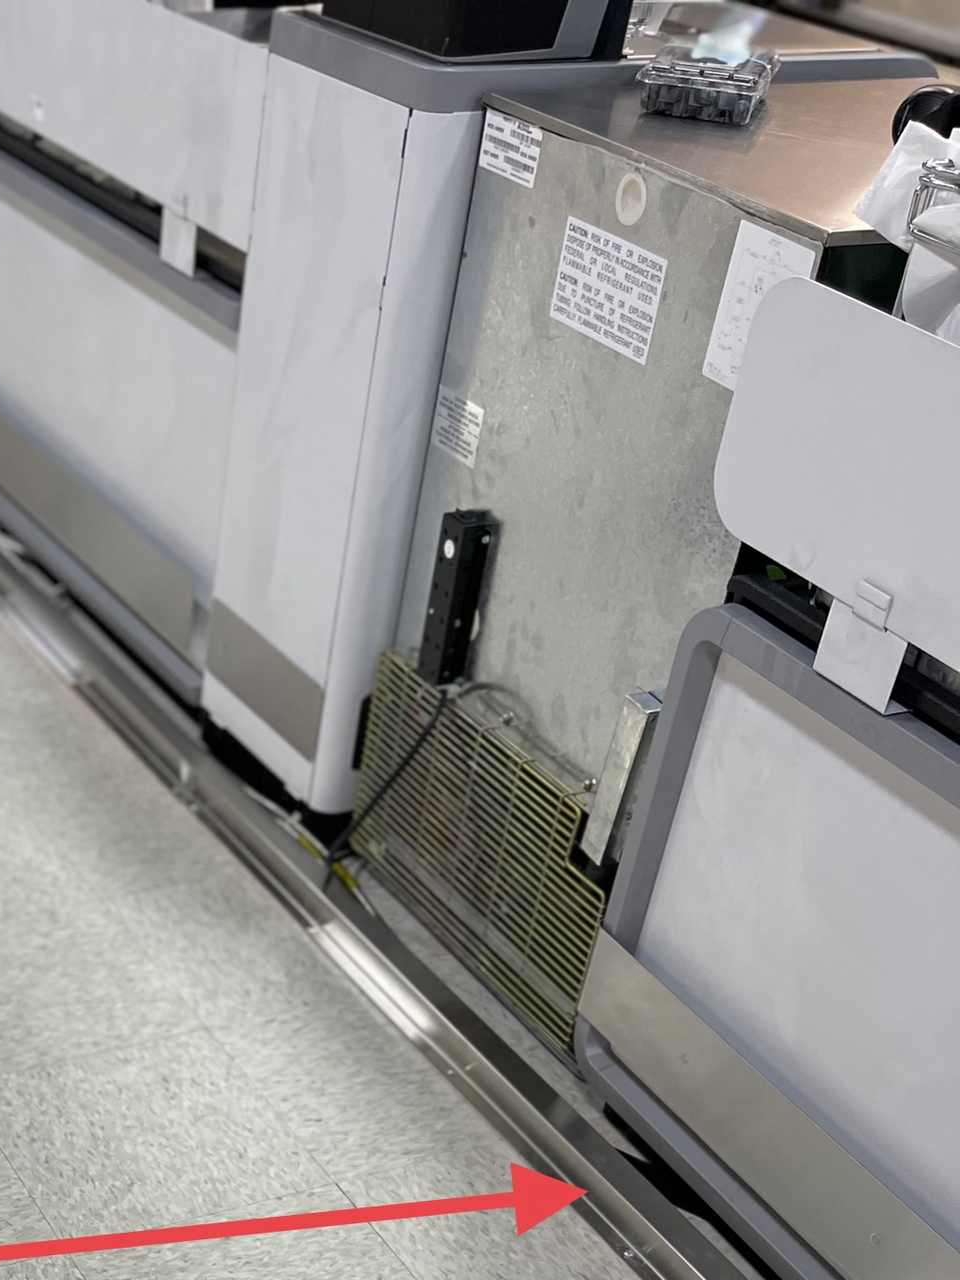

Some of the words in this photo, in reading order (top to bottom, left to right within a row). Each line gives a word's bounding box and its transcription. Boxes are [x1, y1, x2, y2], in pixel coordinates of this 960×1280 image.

[564, 244, 585, 261] FEDERAL
[589, 256, 597, 266] OR
[601, 262, 617, 276] LOCAL
[566, 233, 586, 250] DISPOSE
[585, 242, 592, 251] OF
[592, 245, 615, 262] PROPERLY
[614, 256, 620, 265] IN
[620, 258, 650, 279] ACCORDANCE
[591, 232, 601, 245] RISK
[603, 238, 610, 247] OF
[611, 242, 622, 254] FIRE
[626, 249, 634, 258] OR
[562, 255, 592, 277] FLAMMABLE
[596, 271, 634, 295] REFRIGERANT
[557, 282, 567, 293] DUE
[571, 288, 578, 298] TO
[581, 293, 605, 312] PUNCTURE
[608, 307, 616, 316] OF
[620, 313, 651, 335] REFRIGERANT
[582, 282, 593, 294] RISK
[593, 288, 601, 297] OF
[604, 292, 615, 305] FIRE
[618, 299, 626, 309] OR
[573, 302, 591, 317] FOLLOW
[593, 312, 615, 330] HANDLING
[617, 324, 648, 347] INSTRUCTIONS
[577, 315, 602, 335] FLAMMABLE
[603, 328, 633, 350] REFRIGERANT
